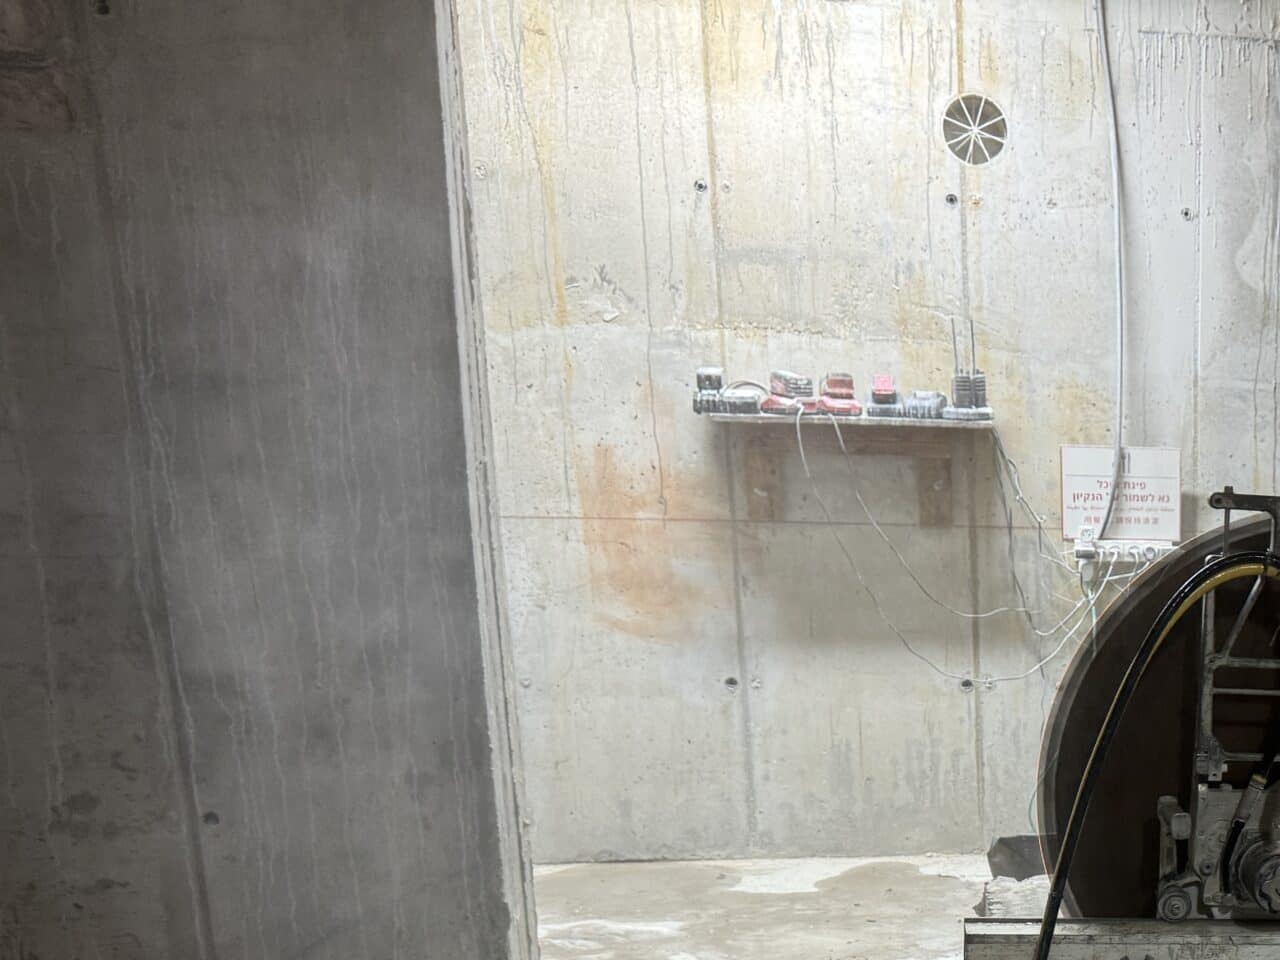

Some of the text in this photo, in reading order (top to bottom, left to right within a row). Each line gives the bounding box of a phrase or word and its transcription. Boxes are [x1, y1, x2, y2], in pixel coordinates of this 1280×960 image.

[1123, 480, 1146, 489] פינת
[1073, 492, 1103, 503] הנקיון
[1122, 493, 1155, 502] לשמור
[1158, 494, 1170, 503] נא
